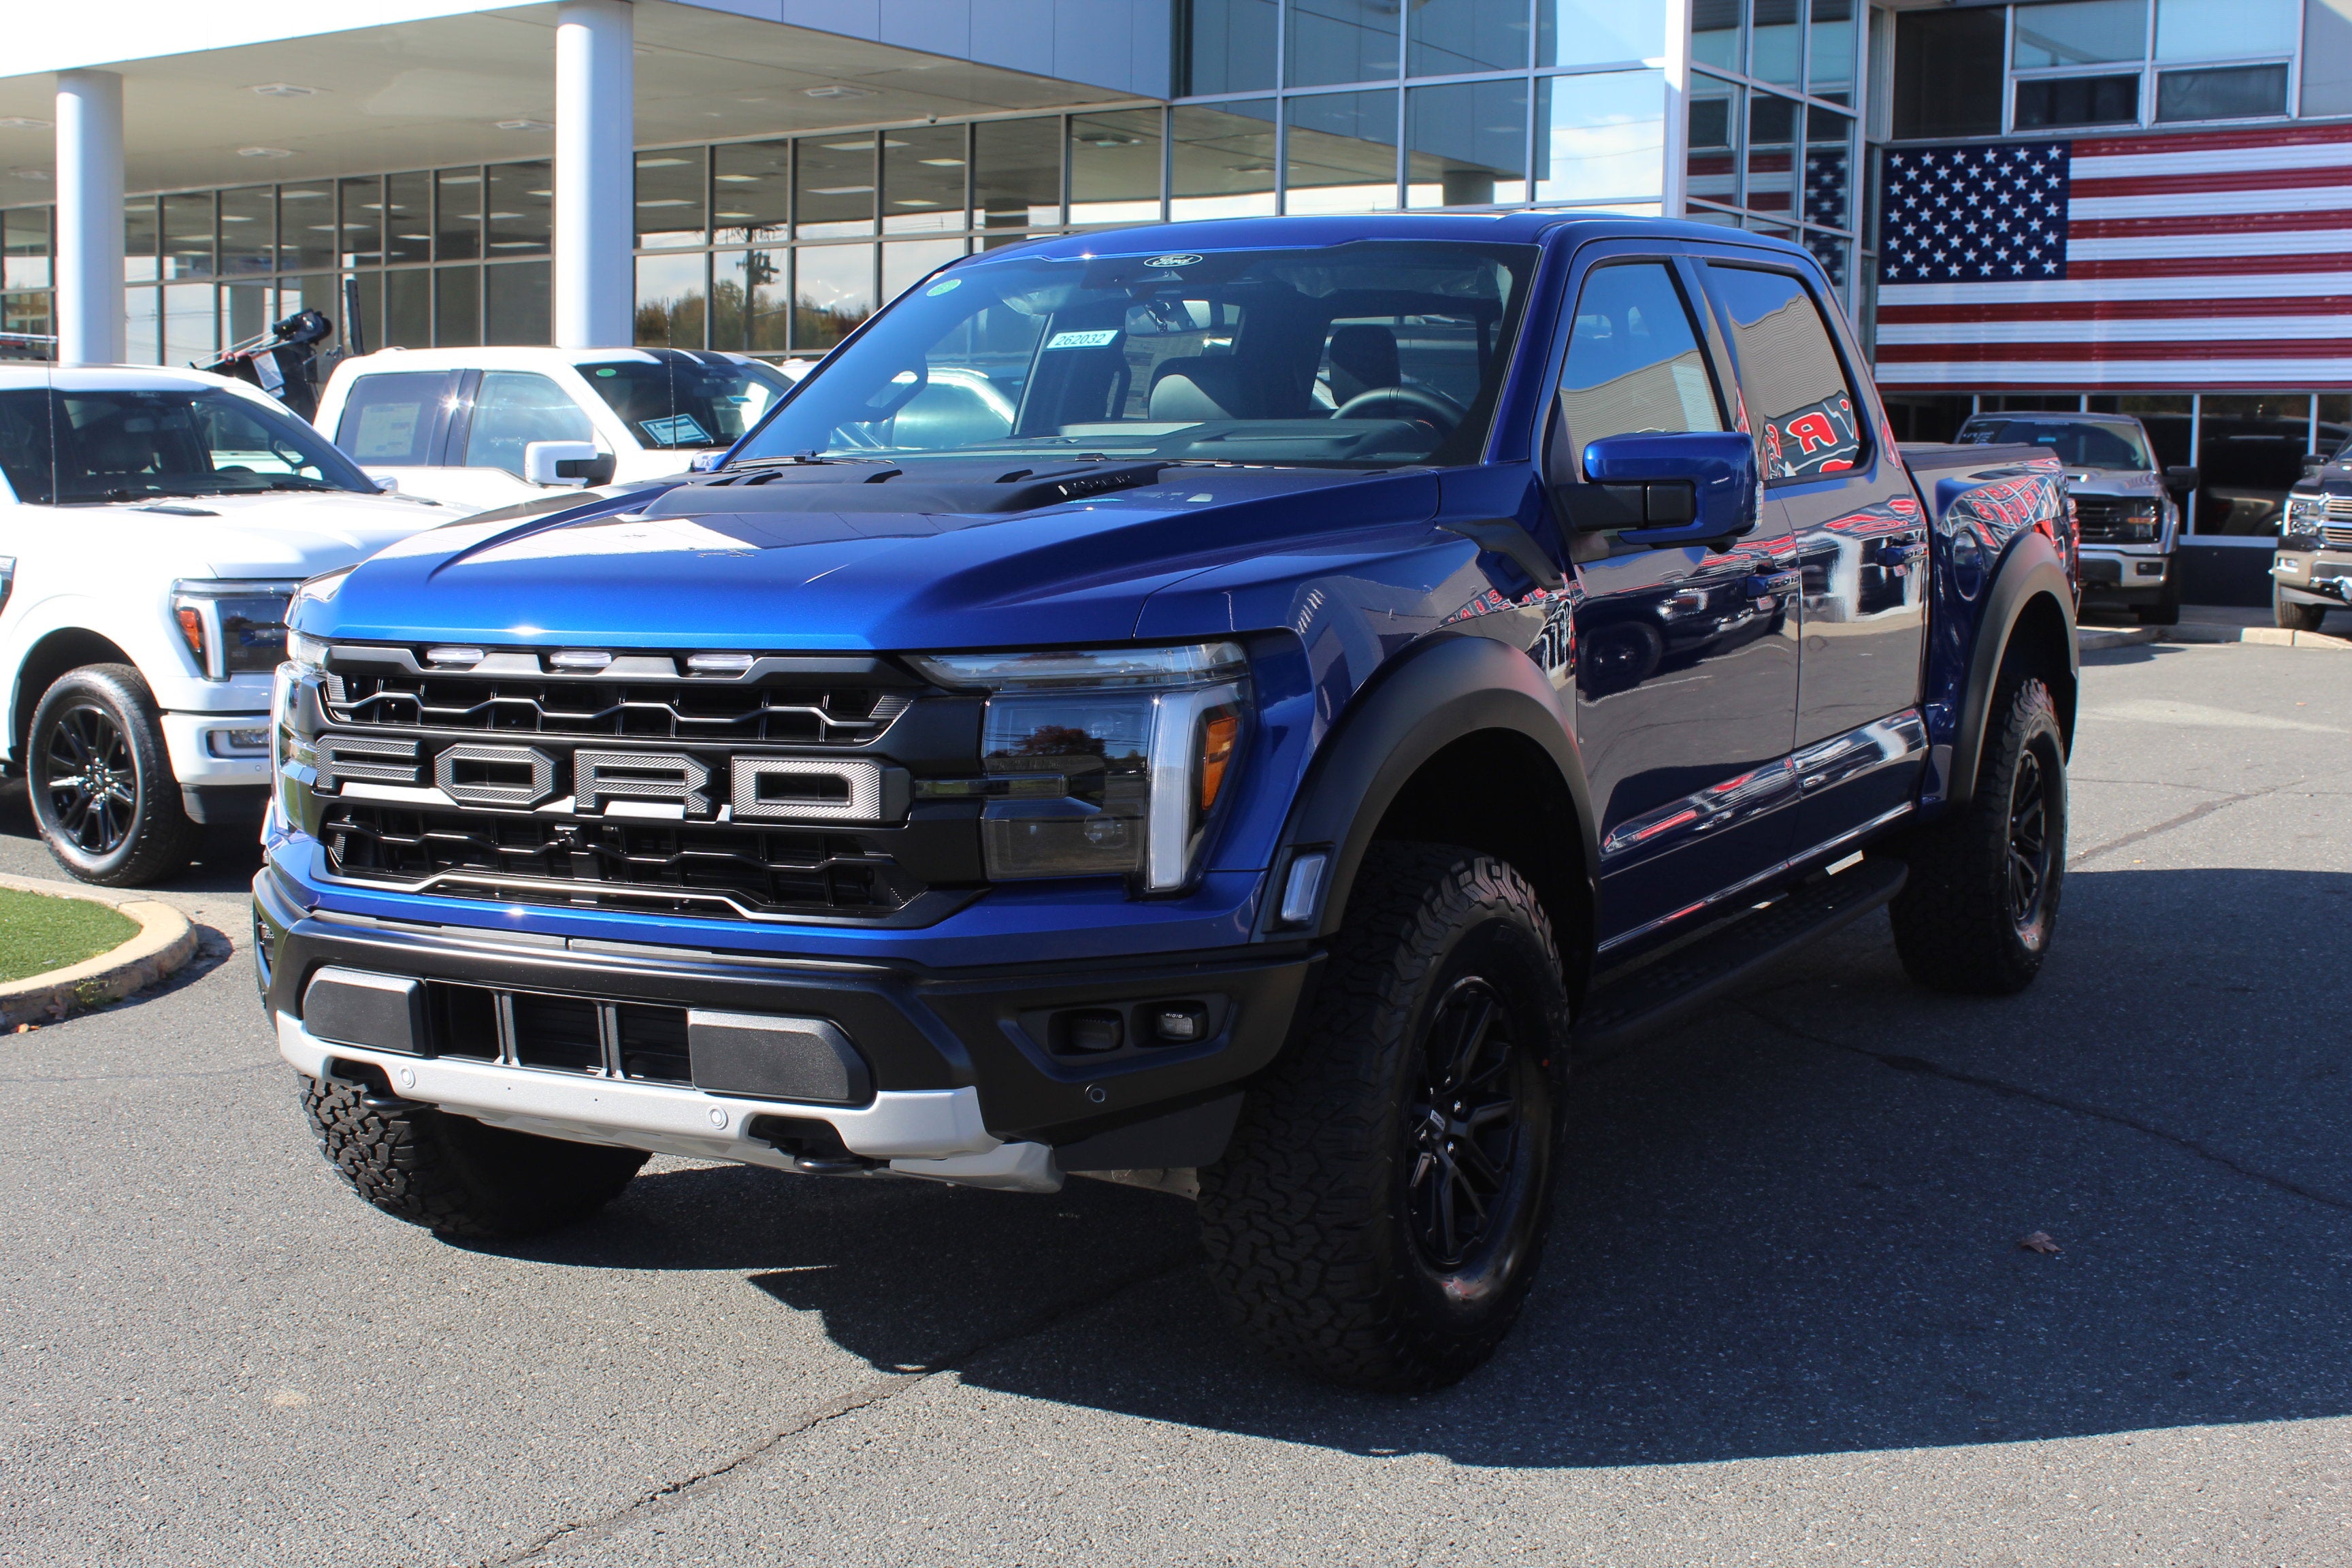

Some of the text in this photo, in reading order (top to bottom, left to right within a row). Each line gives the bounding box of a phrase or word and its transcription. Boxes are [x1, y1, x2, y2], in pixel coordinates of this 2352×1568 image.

[1153, 255, 1194, 265] Ford
[1055, 333, 1107, 346] 262032
[316, 734, 880, 819] FORD
